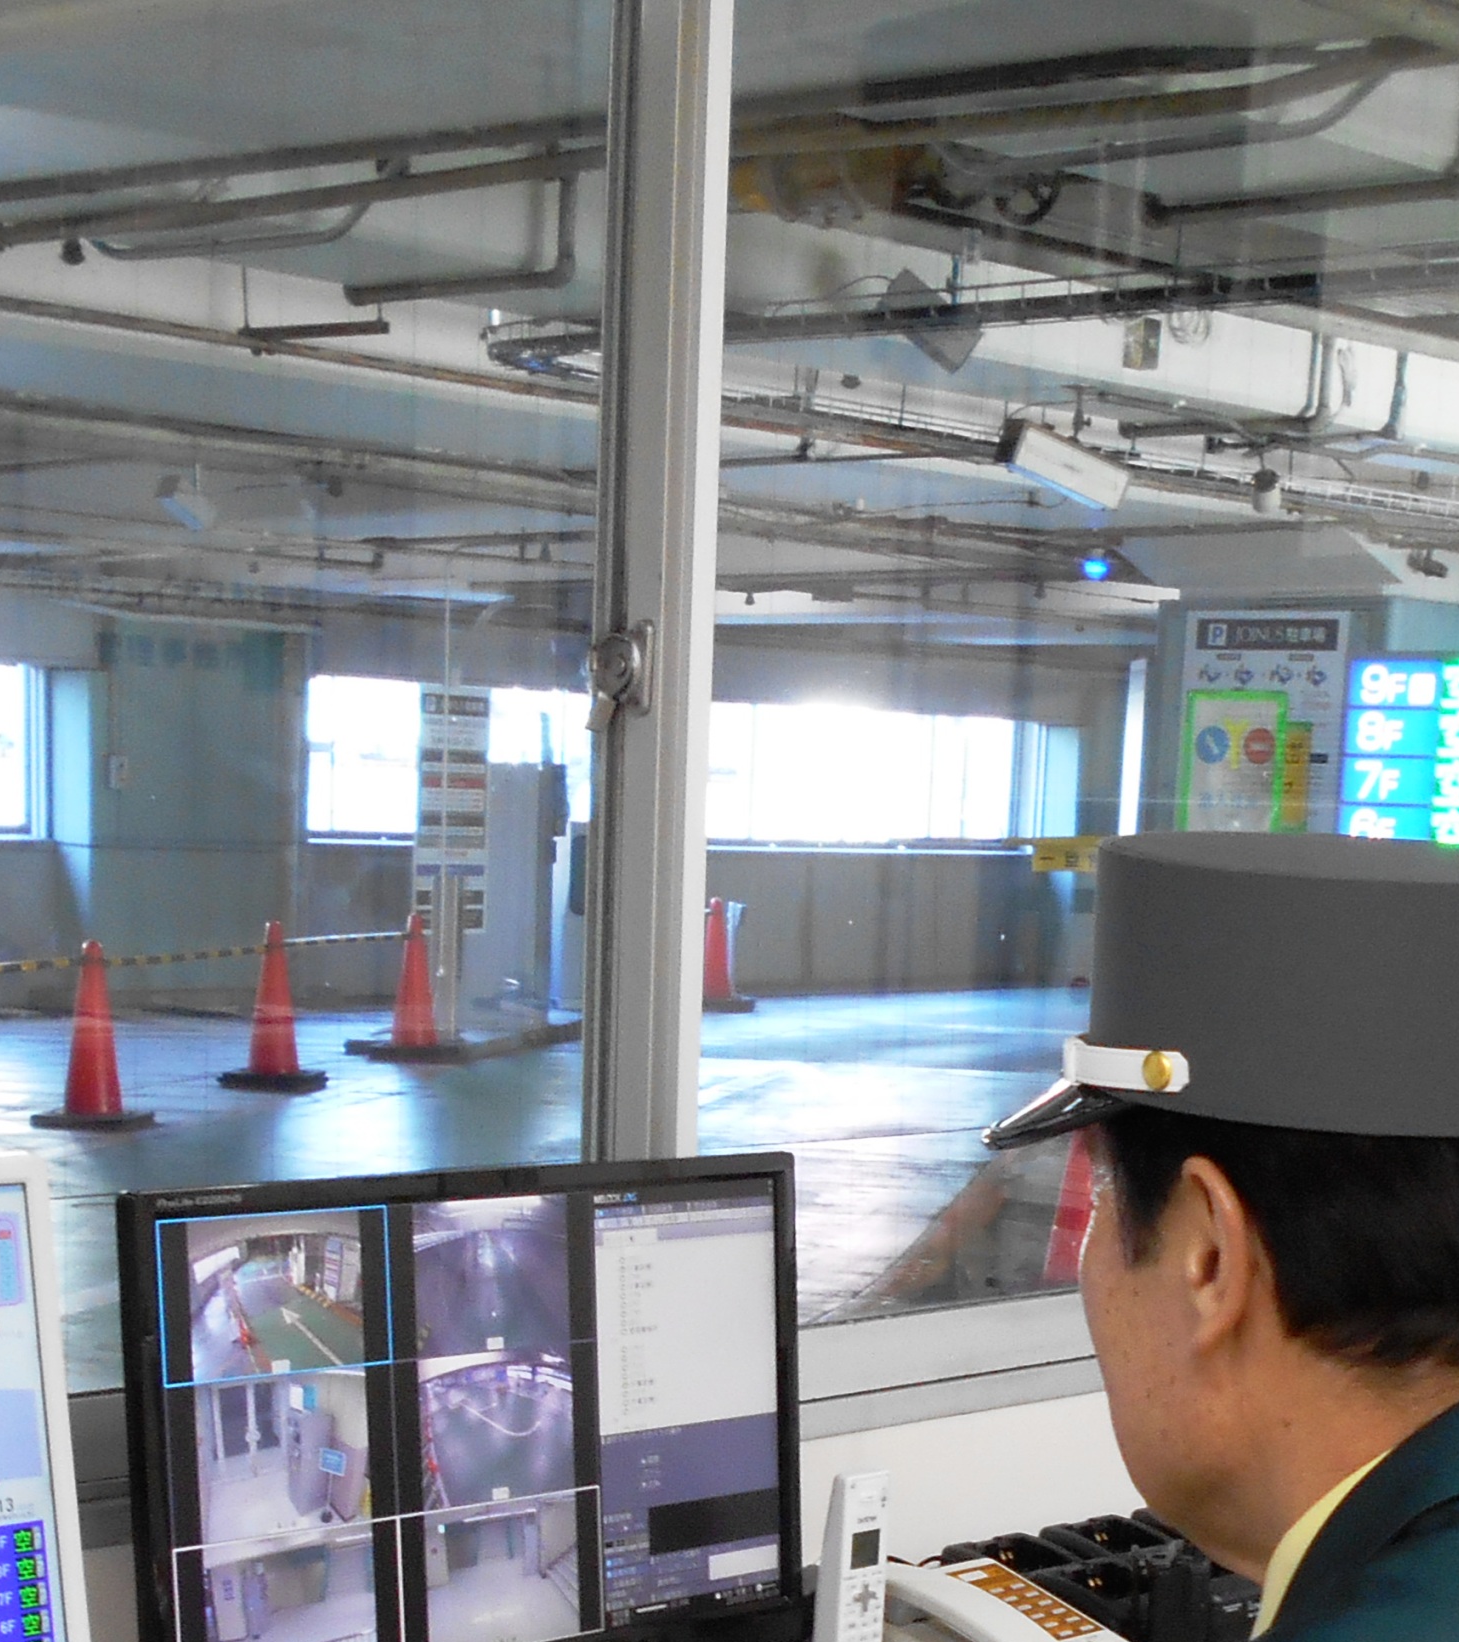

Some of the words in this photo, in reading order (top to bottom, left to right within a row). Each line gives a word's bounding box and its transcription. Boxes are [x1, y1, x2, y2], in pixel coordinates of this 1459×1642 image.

[1360, 664, 1407, 704] 9F
[1356, 711, 1404, 751] 8F
[1354, 760, 1400, 800] 7F
[15, 1530, 33, 1553] 空
[17, 1557, 36, 1580] 空
[19, 1585, 40, 1608] 空
[0, 1619, 17, 1635] 6F
[22, 1613, 42, 1636] 空
